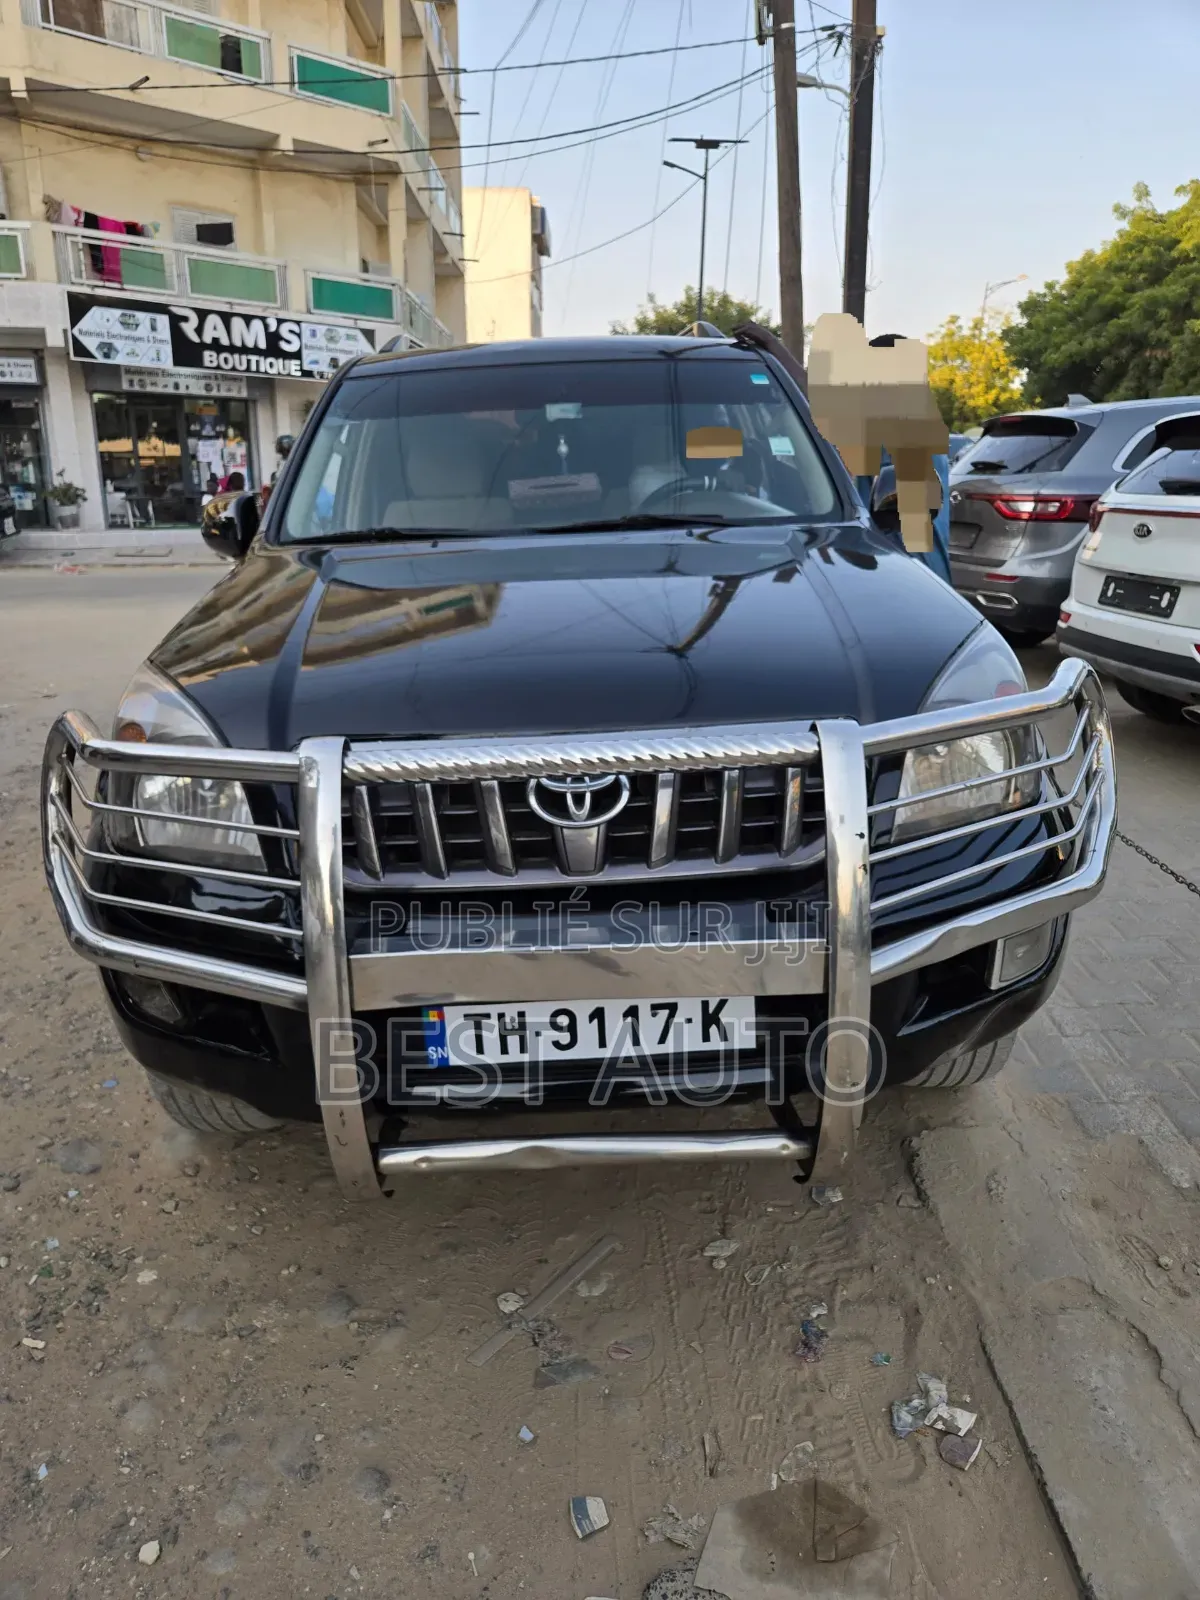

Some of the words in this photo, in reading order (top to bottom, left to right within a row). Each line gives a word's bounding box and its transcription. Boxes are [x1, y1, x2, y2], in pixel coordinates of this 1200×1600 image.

[168, 306, 301, 353] RAM'S
[203, 350, 302, 377] BOUTIQUE
[1133, 525, 1149, 536] KIA
[427, 1046, 448, 1059] SN
